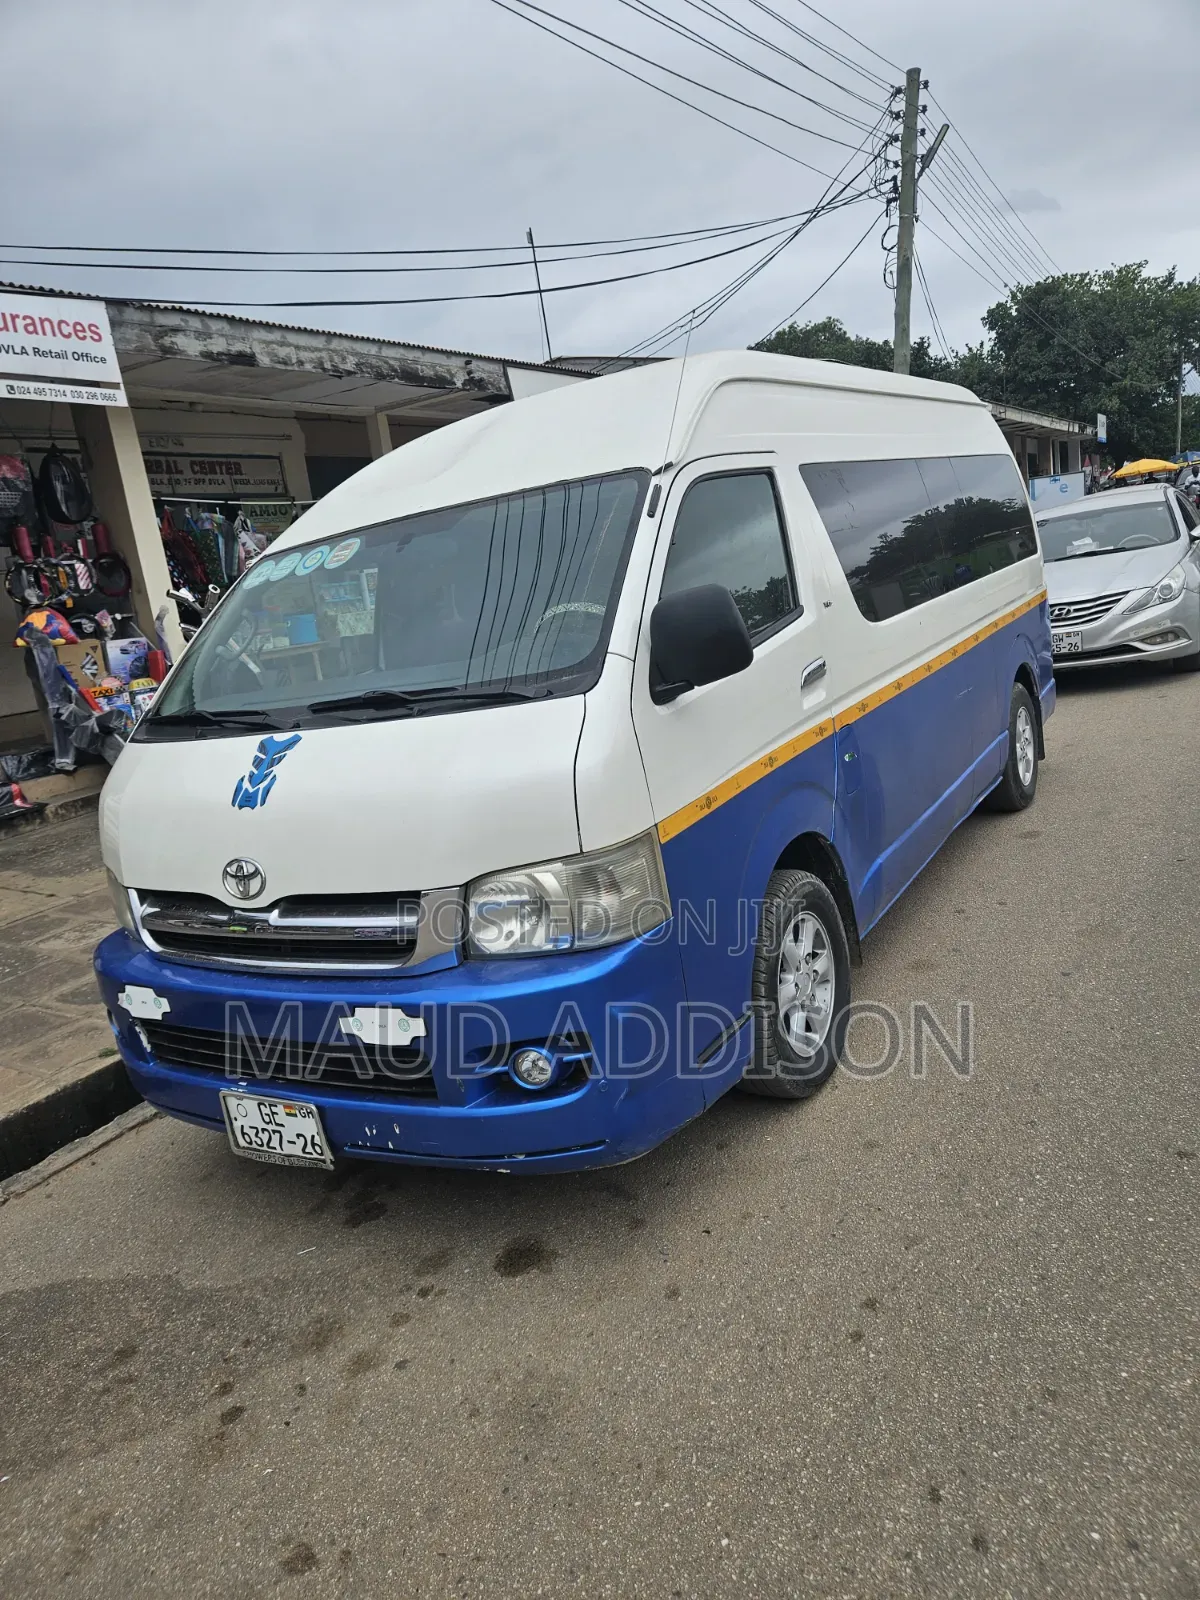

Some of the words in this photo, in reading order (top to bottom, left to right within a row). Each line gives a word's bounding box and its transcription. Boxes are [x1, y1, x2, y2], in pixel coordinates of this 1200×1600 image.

[0, 343, 30, 356] VLA
[32, 346, 69, 360] Retail
[71, 351, 107, 364] Office
[17, 385, 32, 395] 024
[33, 387, 47, 397] 495
[48, 388, 67, 398] 7314
[1052, 634, 1064, 644] GW
[91, 688, 114, 697] TAXI
[257, 1102, 286, 1128] GE
[240, 1124, 324, 1157] 6327-26
